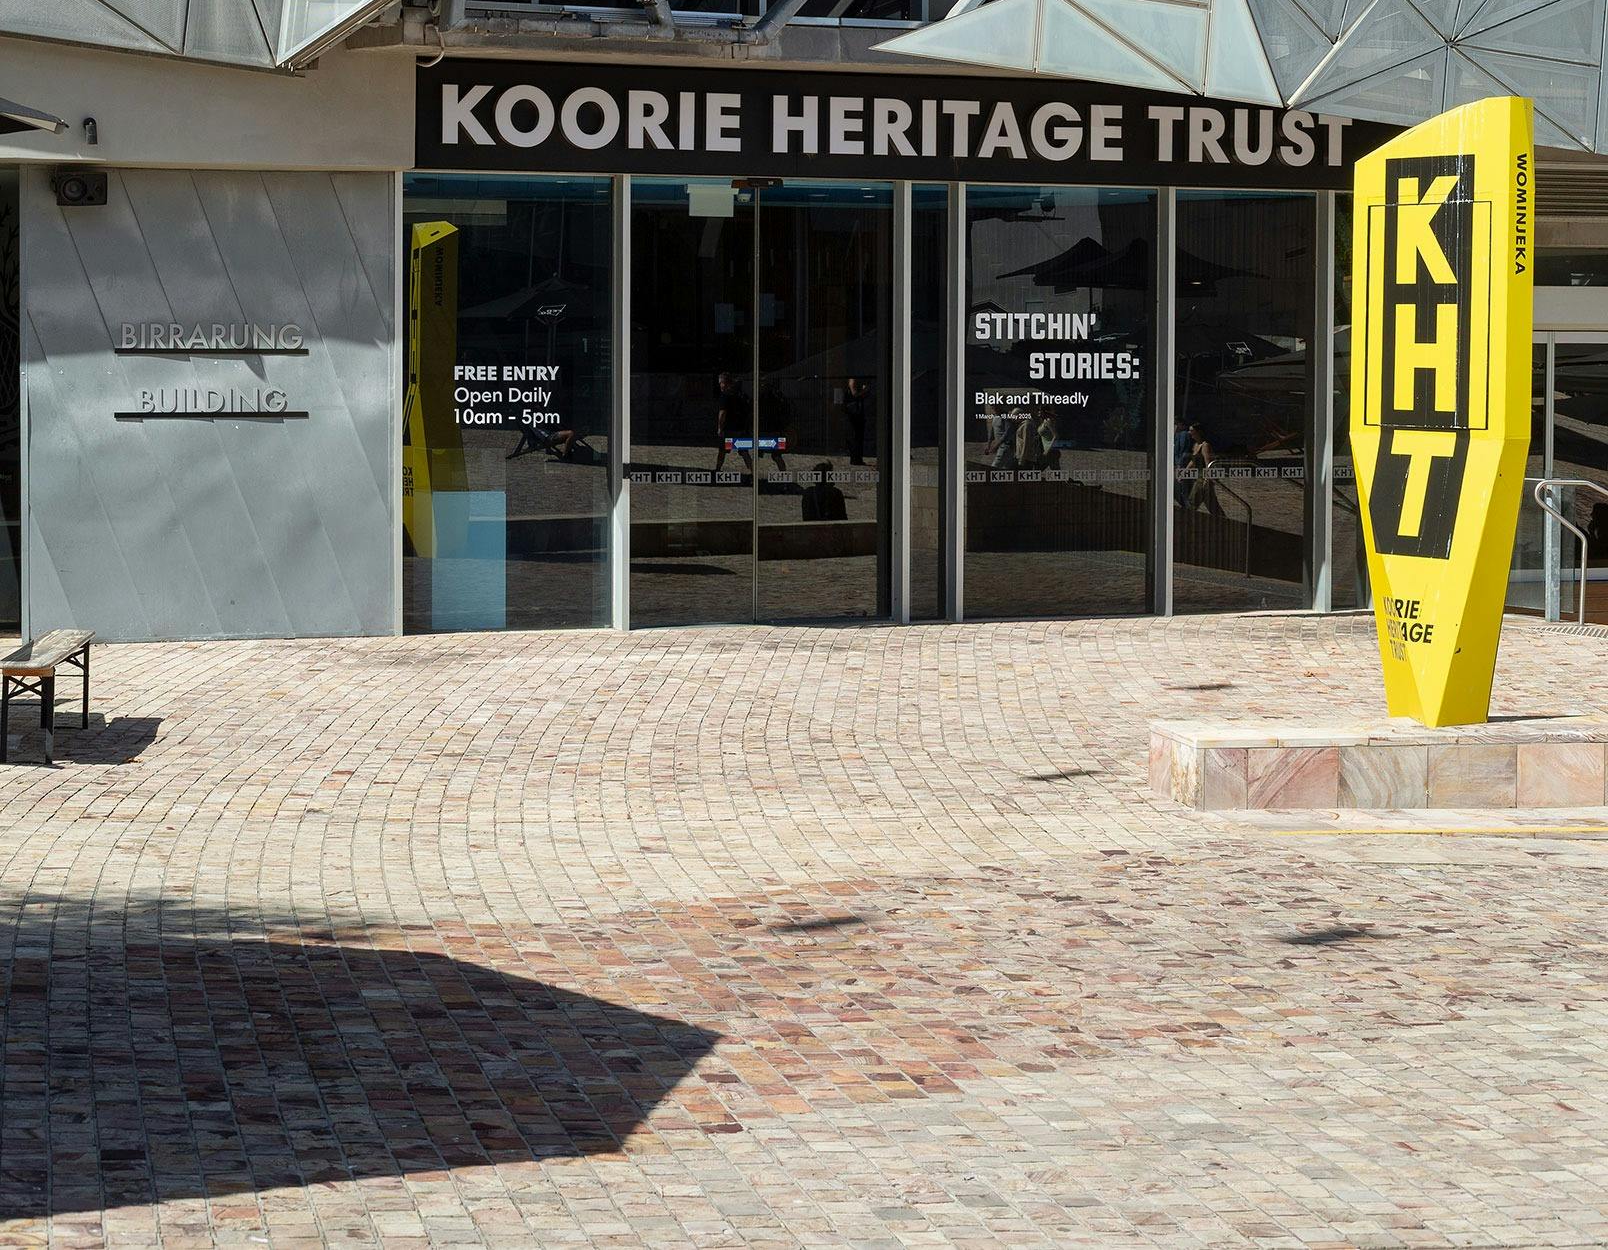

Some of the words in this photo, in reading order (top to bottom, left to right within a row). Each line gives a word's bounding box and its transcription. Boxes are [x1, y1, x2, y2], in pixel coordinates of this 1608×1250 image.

[442, 84, 742, 151] KOORIE
[772, 94, 1124, 162] HERITAGE
[1148, 105, 1354, 167] TRUST
[1515, 153, 1528, 275] WOMINJEKA
[121, 322, 304, 349] BIRRARUNG
[975, 312, 1097, 340] STITCHIN'
[454, 366, 498, 381] FREE
[503, 366, 560, 381] ENTRY
[1029, 352, 1140, 380] STORIES:
[141, 388, 288, 412] BUILDING
[454, 388, 503, 406] Open
[508, 387, 552, 407] Daily
[975, 392, 1004, 405] Blak
[1006, 392, 1030, 405] and
[1032, 392, 1089, 407] Threadly
[454, 409, 502, 424] 10am
[522, 409, 561, 427] 5pm
[657, 472, 681, 482] KHT
[687, 472, 711, 482] KHT
[717, 472, 740, 482] KHT
[769, 471, 791, 481] KHT
[799, 471, 821, 481] KHT
[827, 471, 850, 481] KHT
[992, 472, 1012, 481] KHT
[1019, 471, 1040, 480] KHT
[1047, 471, 1068, 480] KHT
[1177, 469, 1198, 478] KHT
[1204, 469, 1225, 478] KHT
[1230, 469, 1250, 478] KHT
[1256, 469, 1277, 478] KHT
[1283, 469, 1303, 478] KHT
